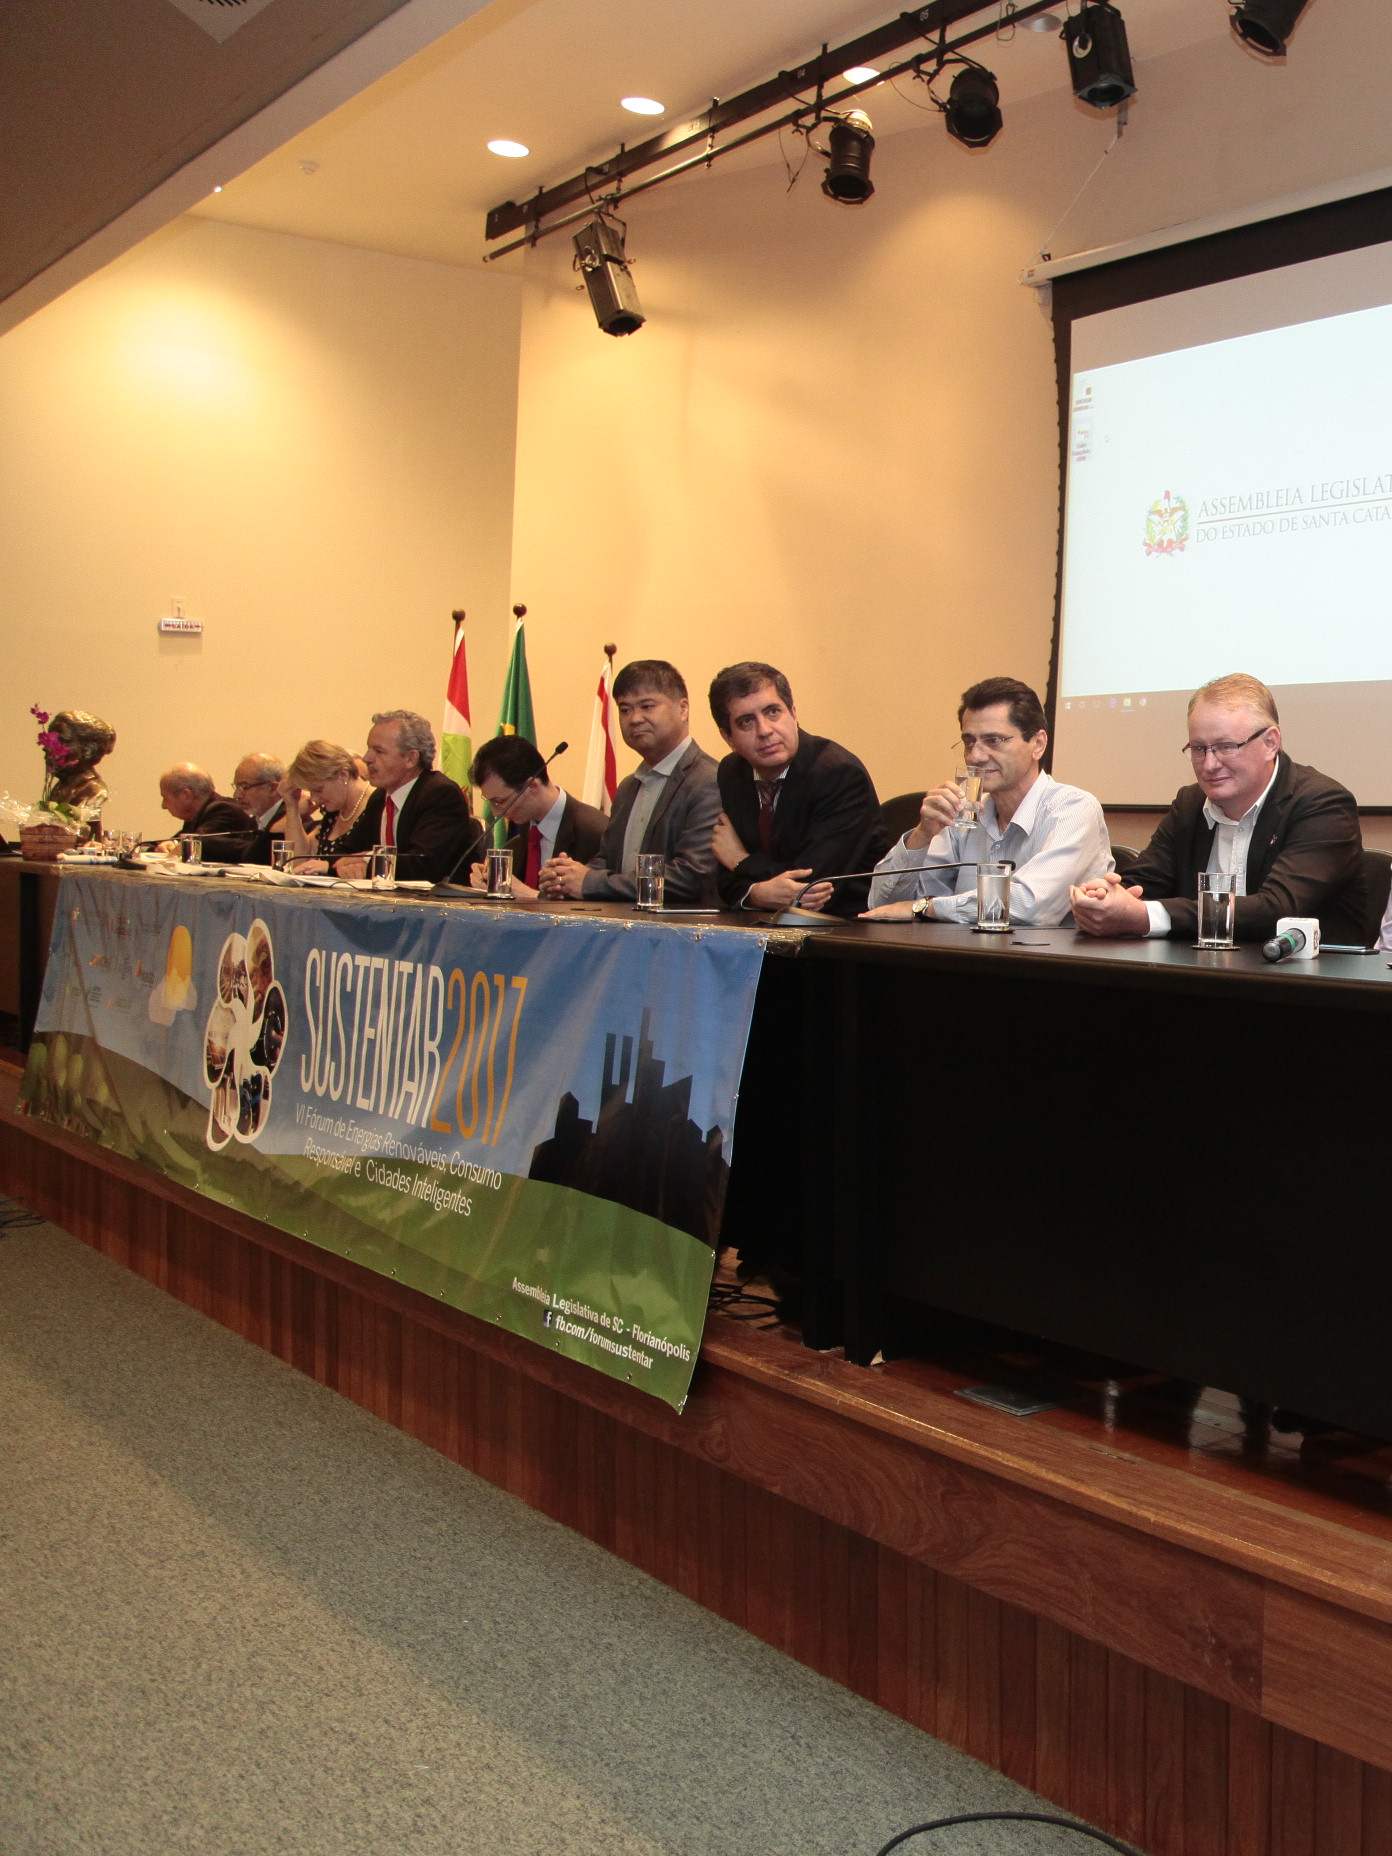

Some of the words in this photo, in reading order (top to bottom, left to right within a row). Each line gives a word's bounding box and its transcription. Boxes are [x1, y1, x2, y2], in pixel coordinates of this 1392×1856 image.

[1196, 527, 1218, 544] DO
[1221, 519, 1275, 540] ESTADO
[1279, 516, 1298, 533] DE
[1301, 510, 1349, 530] SANTA
[1198, 487, 1304, 518] ASSEMBLEIA
[303, 1136, 357, 1175] Responsável
[354, 1160, 362, 1178] e
[366, 1158, 412, 1195] Cidades
[411, 1173, 473, 1217] Inteligentes
[305, 1105, 334, 1135] Fórum
[334, 1116, 346, 1139] de
[346, 1119, 382, 1152] Energias
[382, 1131, 447, 1174] Renováveis,
[450, 1151, 502, 1190] Consumo
[512, 1276, 551, 1306] Assembleia
[552, 1293, 599, 1324] Legislativa
[600, 1311, 611, 1329] de
[612, 1316, 624, 1335] SC
[632, 1323, 691, 1362] Florianópolis
[555, 1315, 654, 1369] fb.com/forumsustentar
